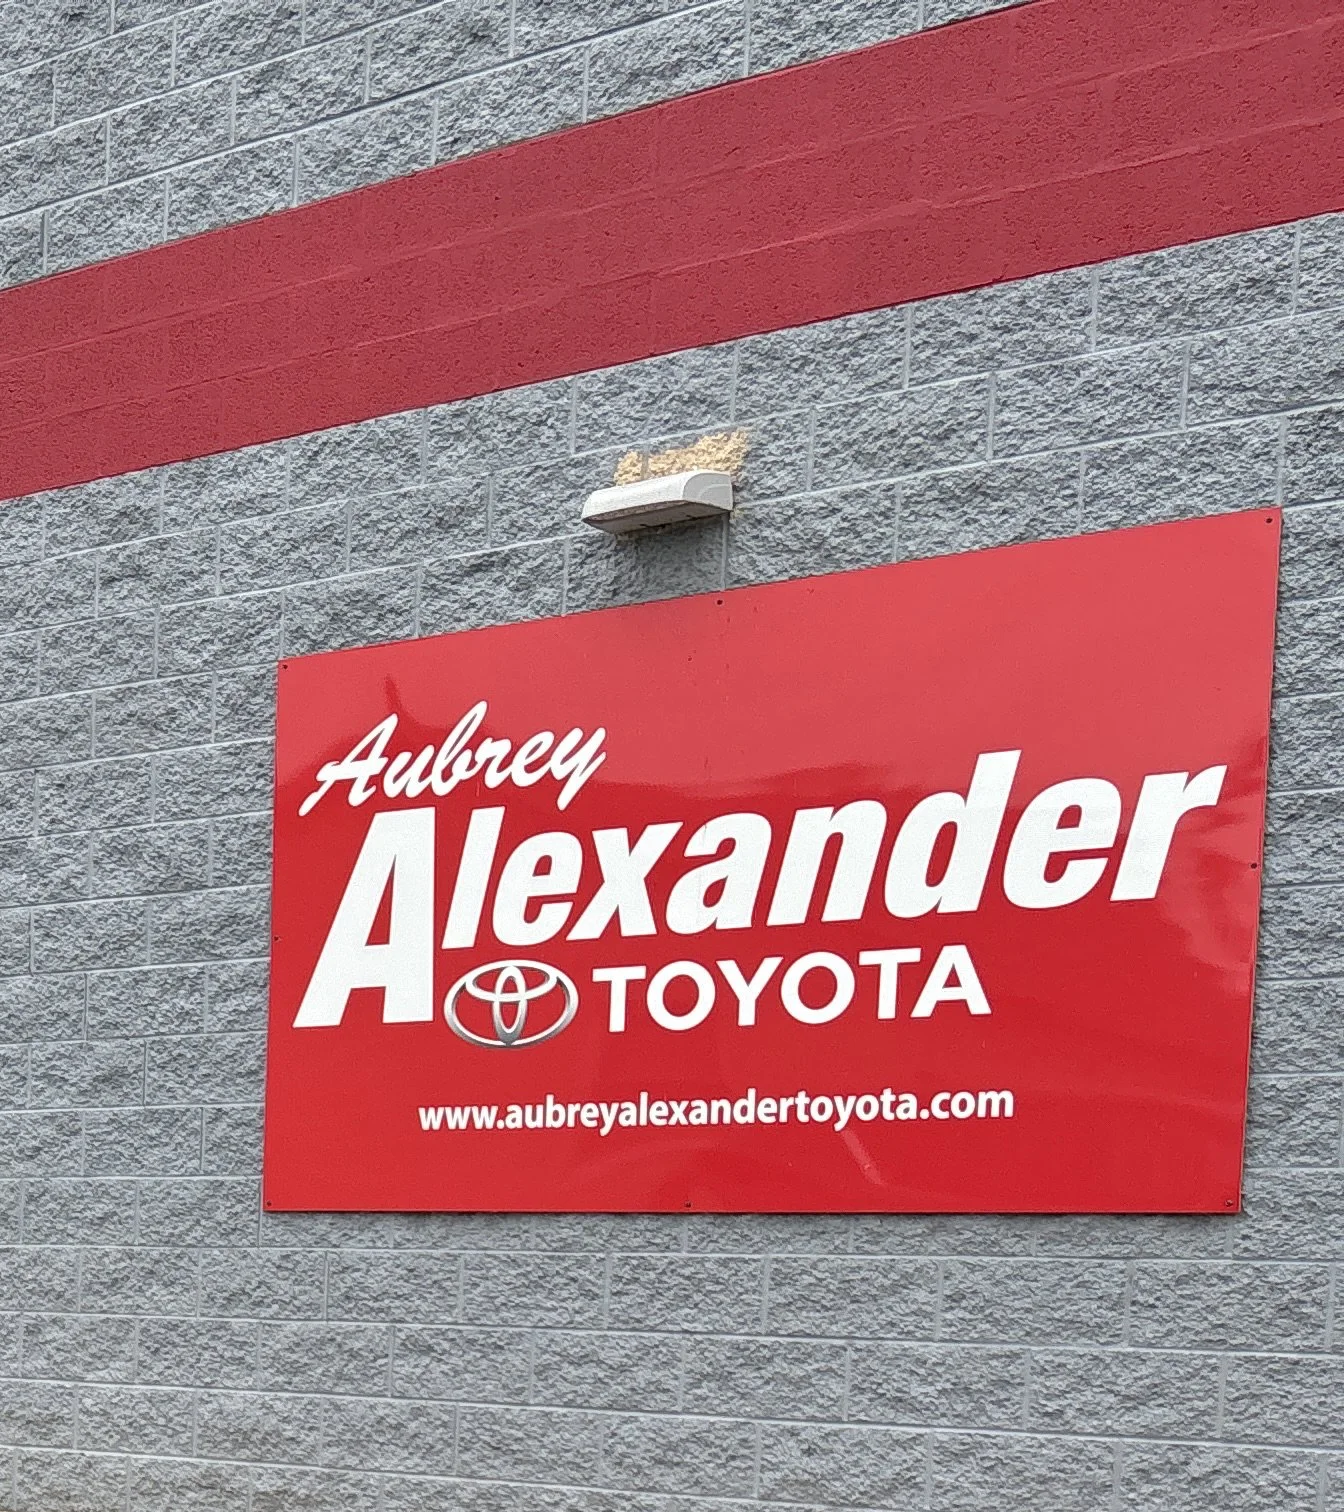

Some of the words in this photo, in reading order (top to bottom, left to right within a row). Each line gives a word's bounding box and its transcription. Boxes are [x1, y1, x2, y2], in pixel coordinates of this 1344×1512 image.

[298, 700, 608, 818] Aubrey
[292, 748, 1229, 1029] Alexander
[592, 944, 992, 1034] TOYOTA
[418, 1086, 1015, 1138] www.aubreyalexandertoyota.com
